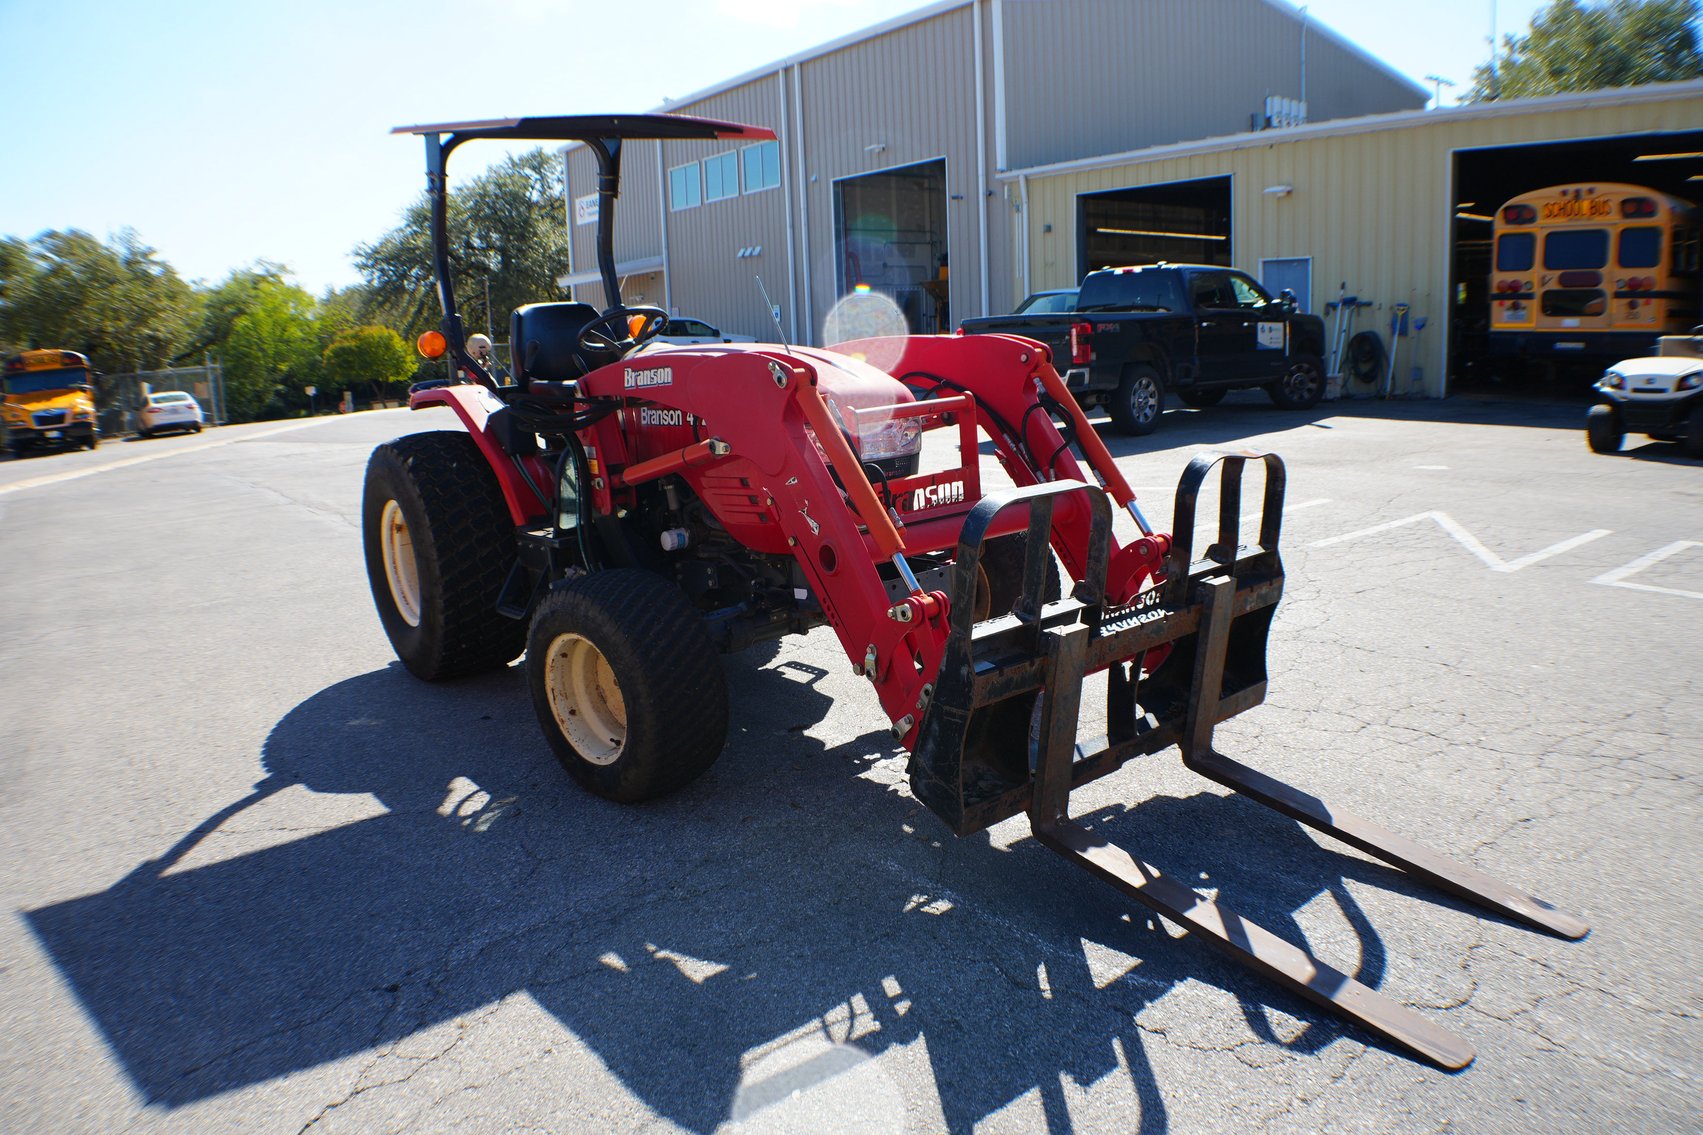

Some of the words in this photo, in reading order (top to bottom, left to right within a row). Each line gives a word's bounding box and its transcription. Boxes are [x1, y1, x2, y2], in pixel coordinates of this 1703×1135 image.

[1543, 199, 1585, 218] SCHOOL
[1589, 198, 1612, 216] BUS
[624, 367, 672, 389] Branson
[640, 407, 683, 426] Branson
